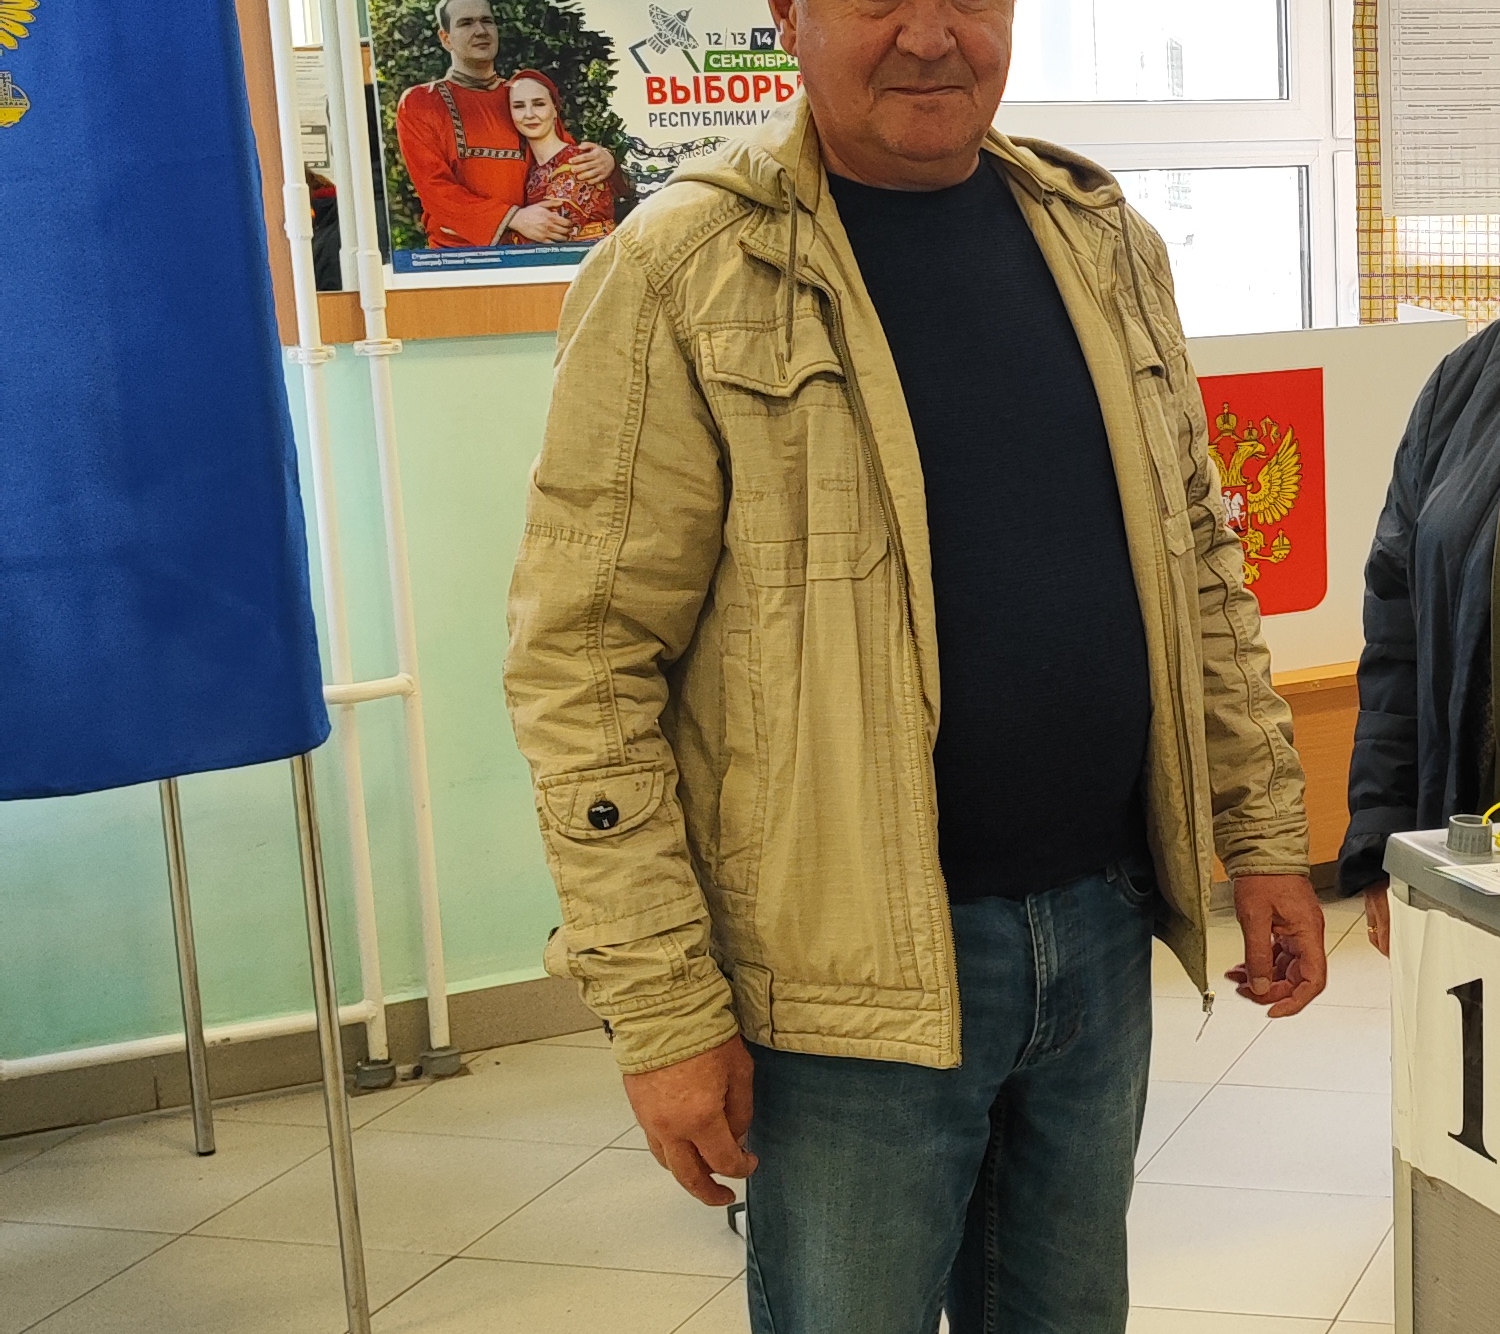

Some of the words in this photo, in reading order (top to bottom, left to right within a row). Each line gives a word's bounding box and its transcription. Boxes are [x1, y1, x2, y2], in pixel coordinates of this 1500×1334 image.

[705, 32, 723, 45] 12
[730, 32, 747, 45] 13
[754, 31, 773, 46] 14
[708, 54, 799, 68] СЕНТЯБРЯ
[648, 110, 757, 127] РЕСПУБЛИКИ
[1446, 978, 1498, 1165] 1
